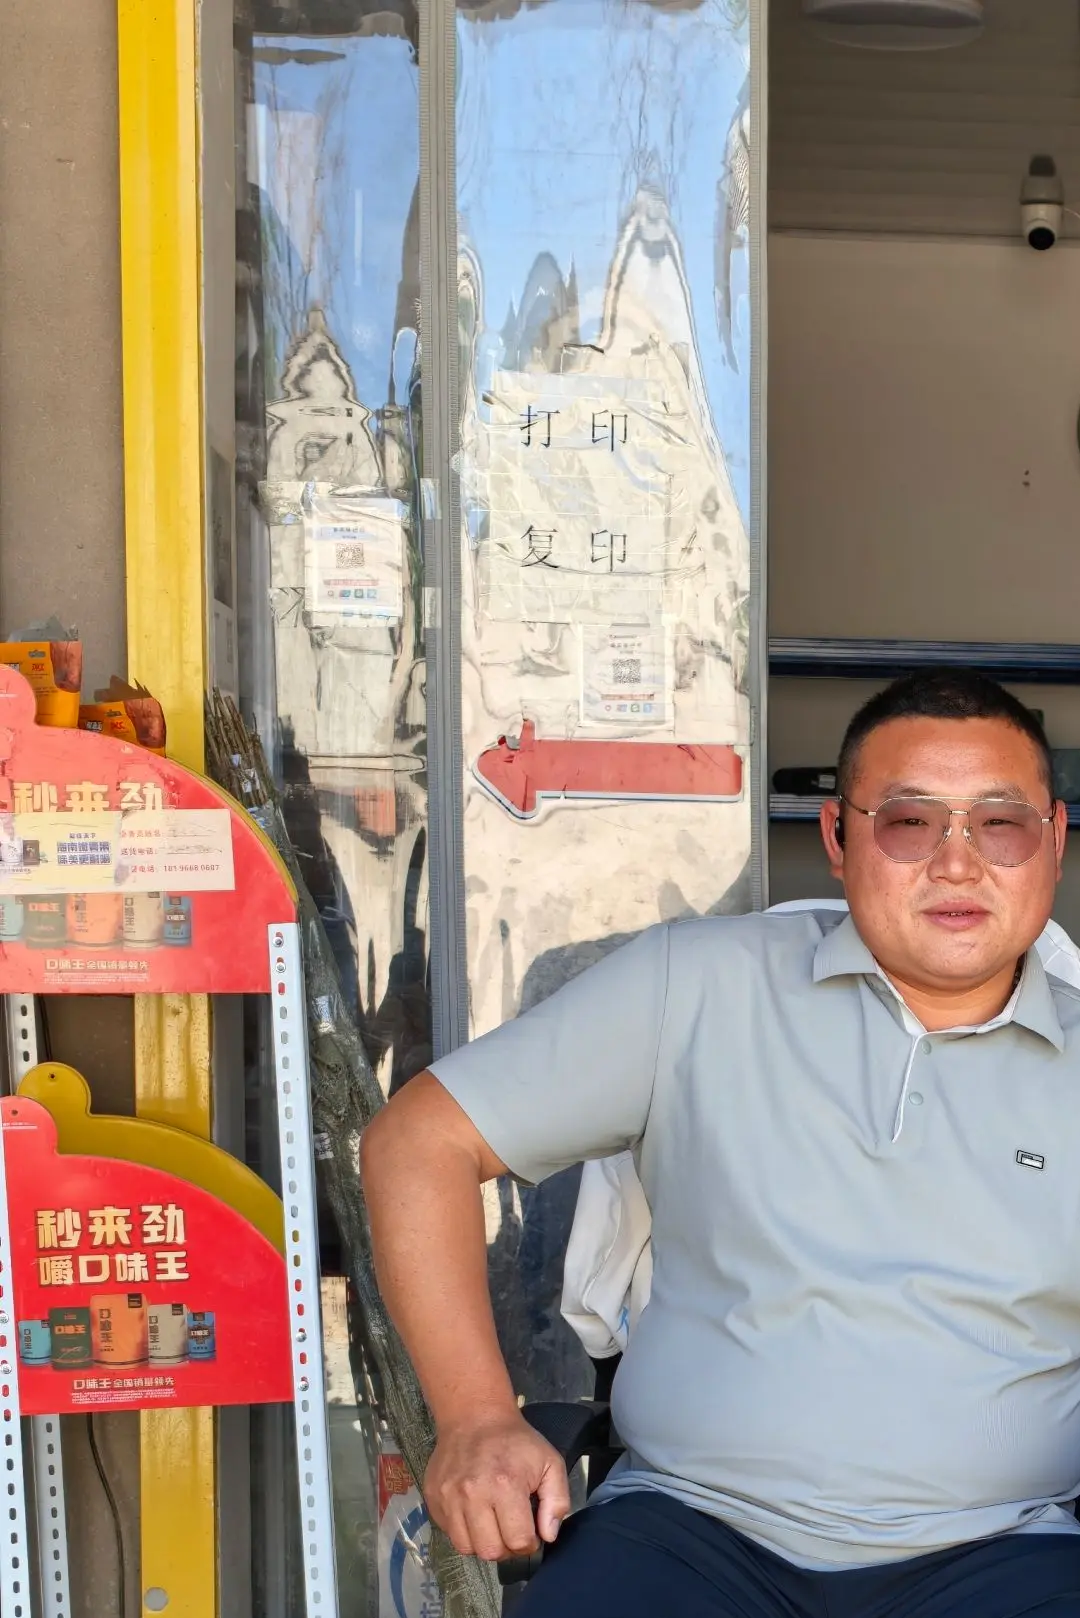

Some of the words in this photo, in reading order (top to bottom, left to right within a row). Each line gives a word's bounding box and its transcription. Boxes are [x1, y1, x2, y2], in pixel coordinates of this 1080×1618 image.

[519, 404, 629, 452] 打印
[520, 525, 629, 573] 复印
[12, 781, 163, 813] 秒来劲
[36, 1203, 188, 1249] 秒来劲
[38, 1250, 190, 1286] 嚼口味王
